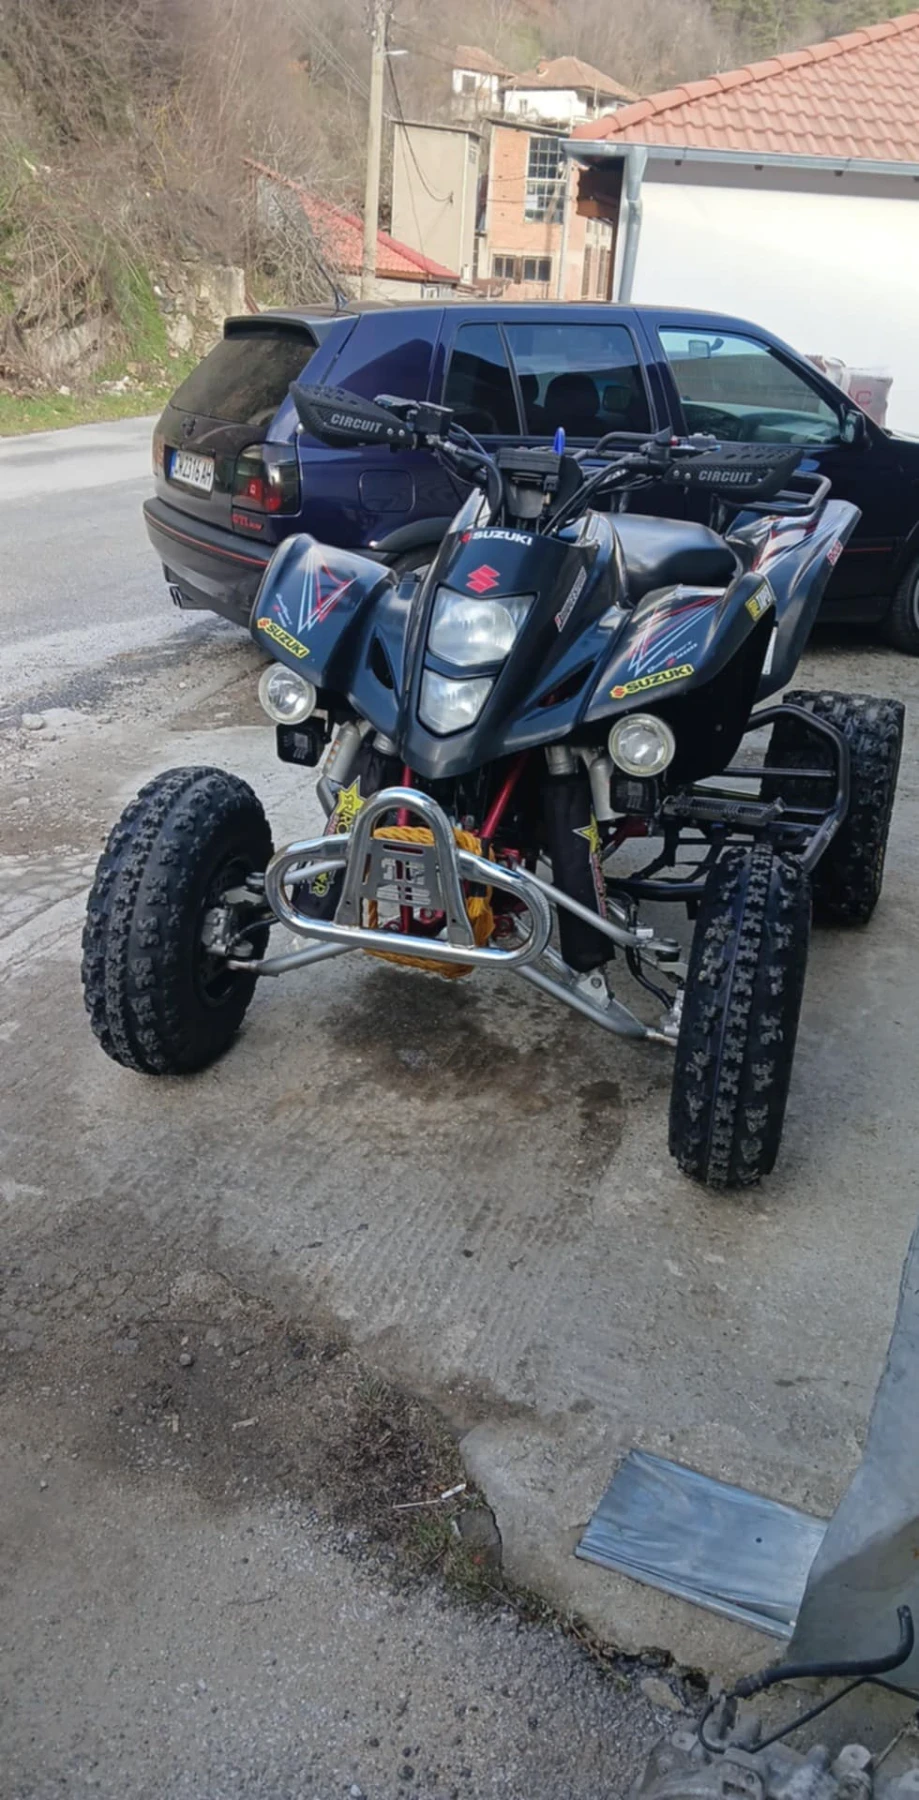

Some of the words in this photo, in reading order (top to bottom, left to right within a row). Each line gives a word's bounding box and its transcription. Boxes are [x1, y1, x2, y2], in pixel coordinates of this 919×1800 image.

[330, 413, 383, 433] CIRCUIT
[698, 470, 752, 483] CIRCUIT
[472, 530, 533, 546] SUZUKI
[266, 622, 308, 657] SUZUKI
[625, 665, 692, 692] SUZUKI
